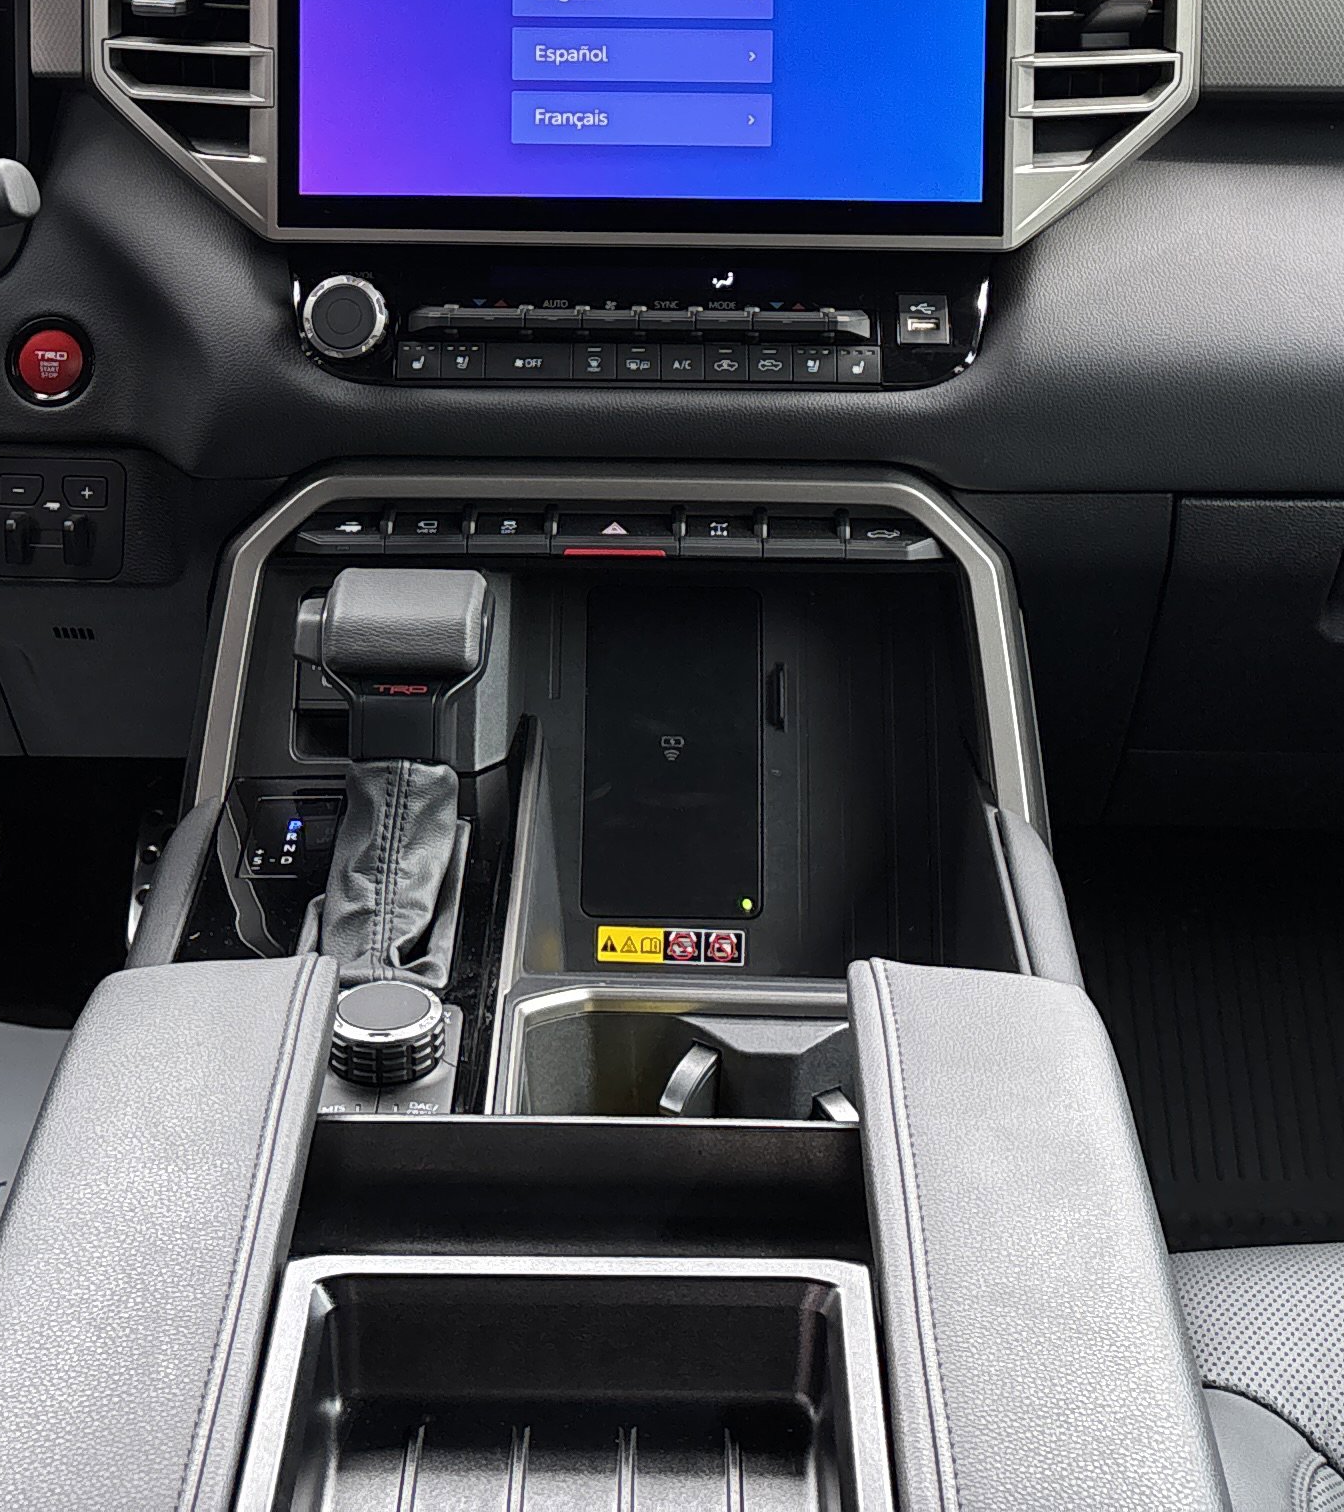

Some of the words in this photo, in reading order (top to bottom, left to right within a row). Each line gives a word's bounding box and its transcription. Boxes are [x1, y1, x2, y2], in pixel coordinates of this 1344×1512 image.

[535, 44, 609, 66] Español
[534, 108, 609, 130] Français
[542, 299, 569, 308] AUTO
[654, 300, 680, 309] SYNC
[708, 301, 737, 310] MODE
[34, 350, 68, 361] TRD
[525, 358, 543, 368] OFF
[672, 359, 692, 370] A/C
[373, 684, 428, 694] TRD
[289, 820, 303, 830] P
[286, 832, 298, 841] R
[283, 843, 296, 852] N
[253, 856, 263, 865] S
[280, 856, 293, 865] D
[321, 1104, 346, 1113] MTS
